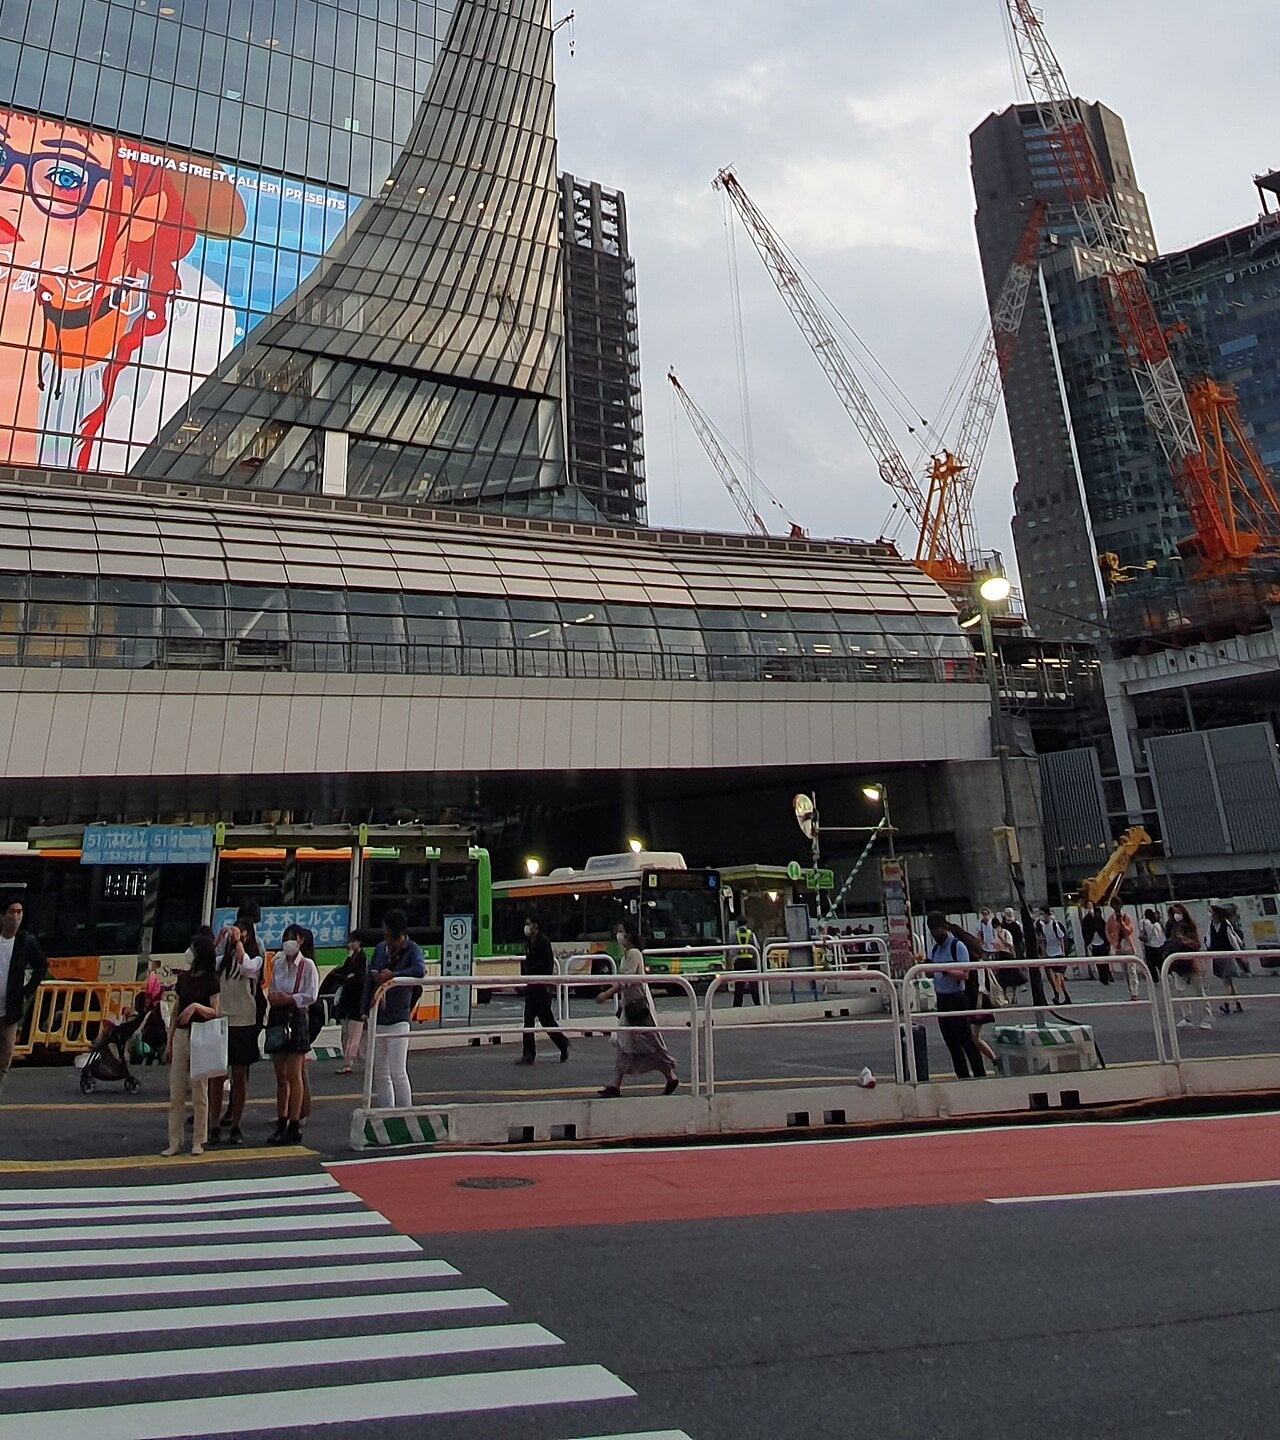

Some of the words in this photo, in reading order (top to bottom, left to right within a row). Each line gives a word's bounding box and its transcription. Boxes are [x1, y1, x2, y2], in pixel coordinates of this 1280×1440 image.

[117, 146, 177, 171] SHIBUYA
[179, 162, 228, 182] STREET
[228, 172, 284, 195] GALLERY
[285, 187, 347, 210] PRESENTS
